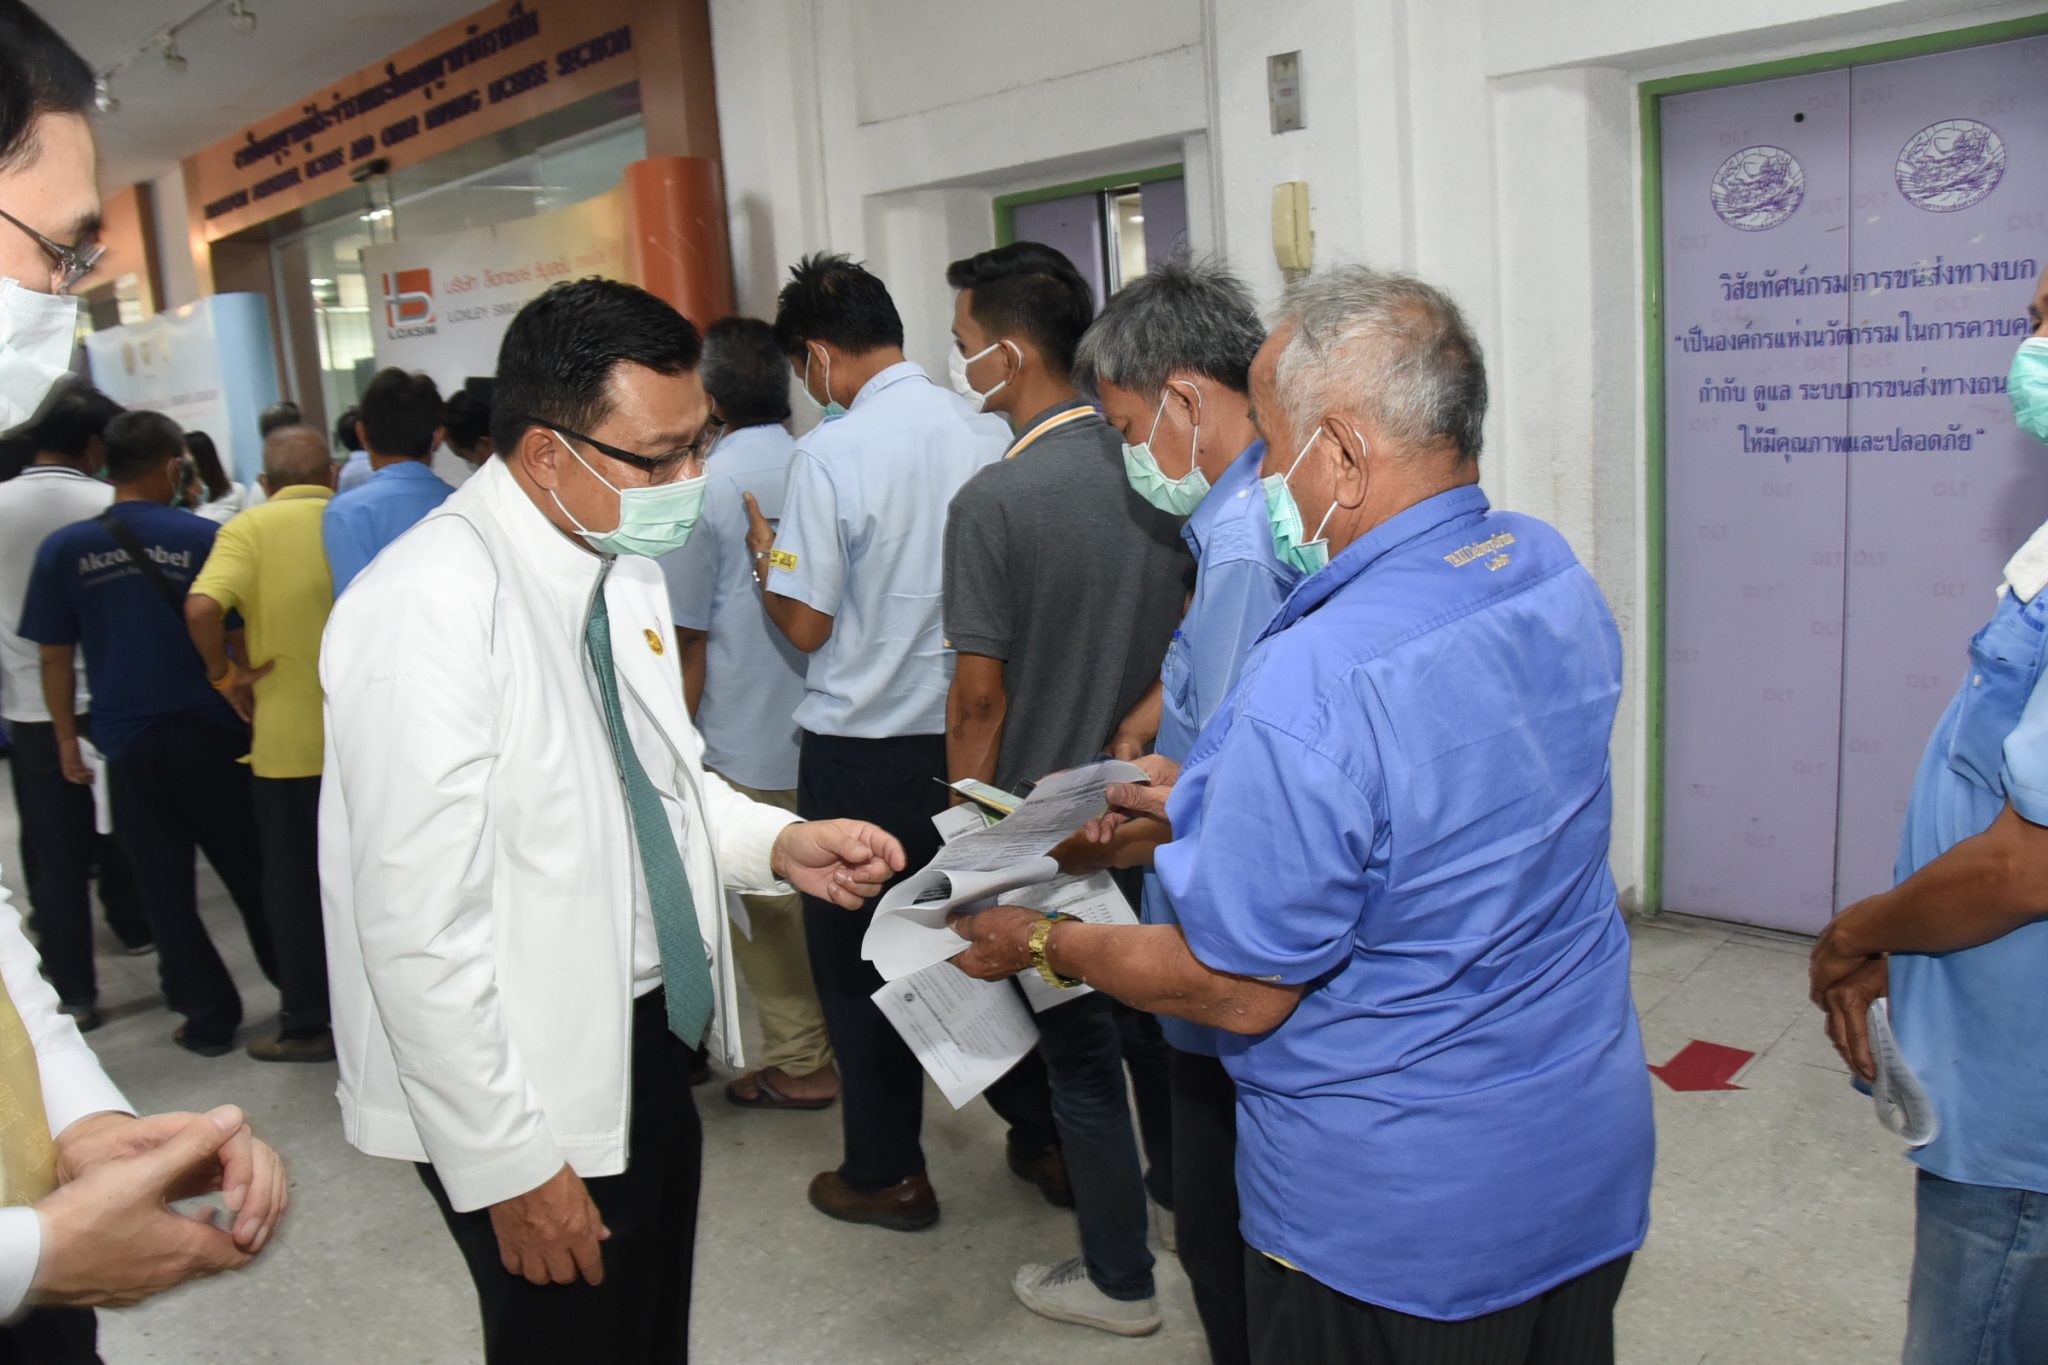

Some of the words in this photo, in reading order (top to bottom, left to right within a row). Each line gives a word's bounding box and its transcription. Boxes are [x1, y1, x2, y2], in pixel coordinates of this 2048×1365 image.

[489, 59, 549, 104] LICENSE
[556, 25, 632, 77] SECTION
[388, 325, 438, 341] LOXSIM
[1699, 377, 1746, 403] กำกับ
[1753, 382, 1791, 412] ดูแล
